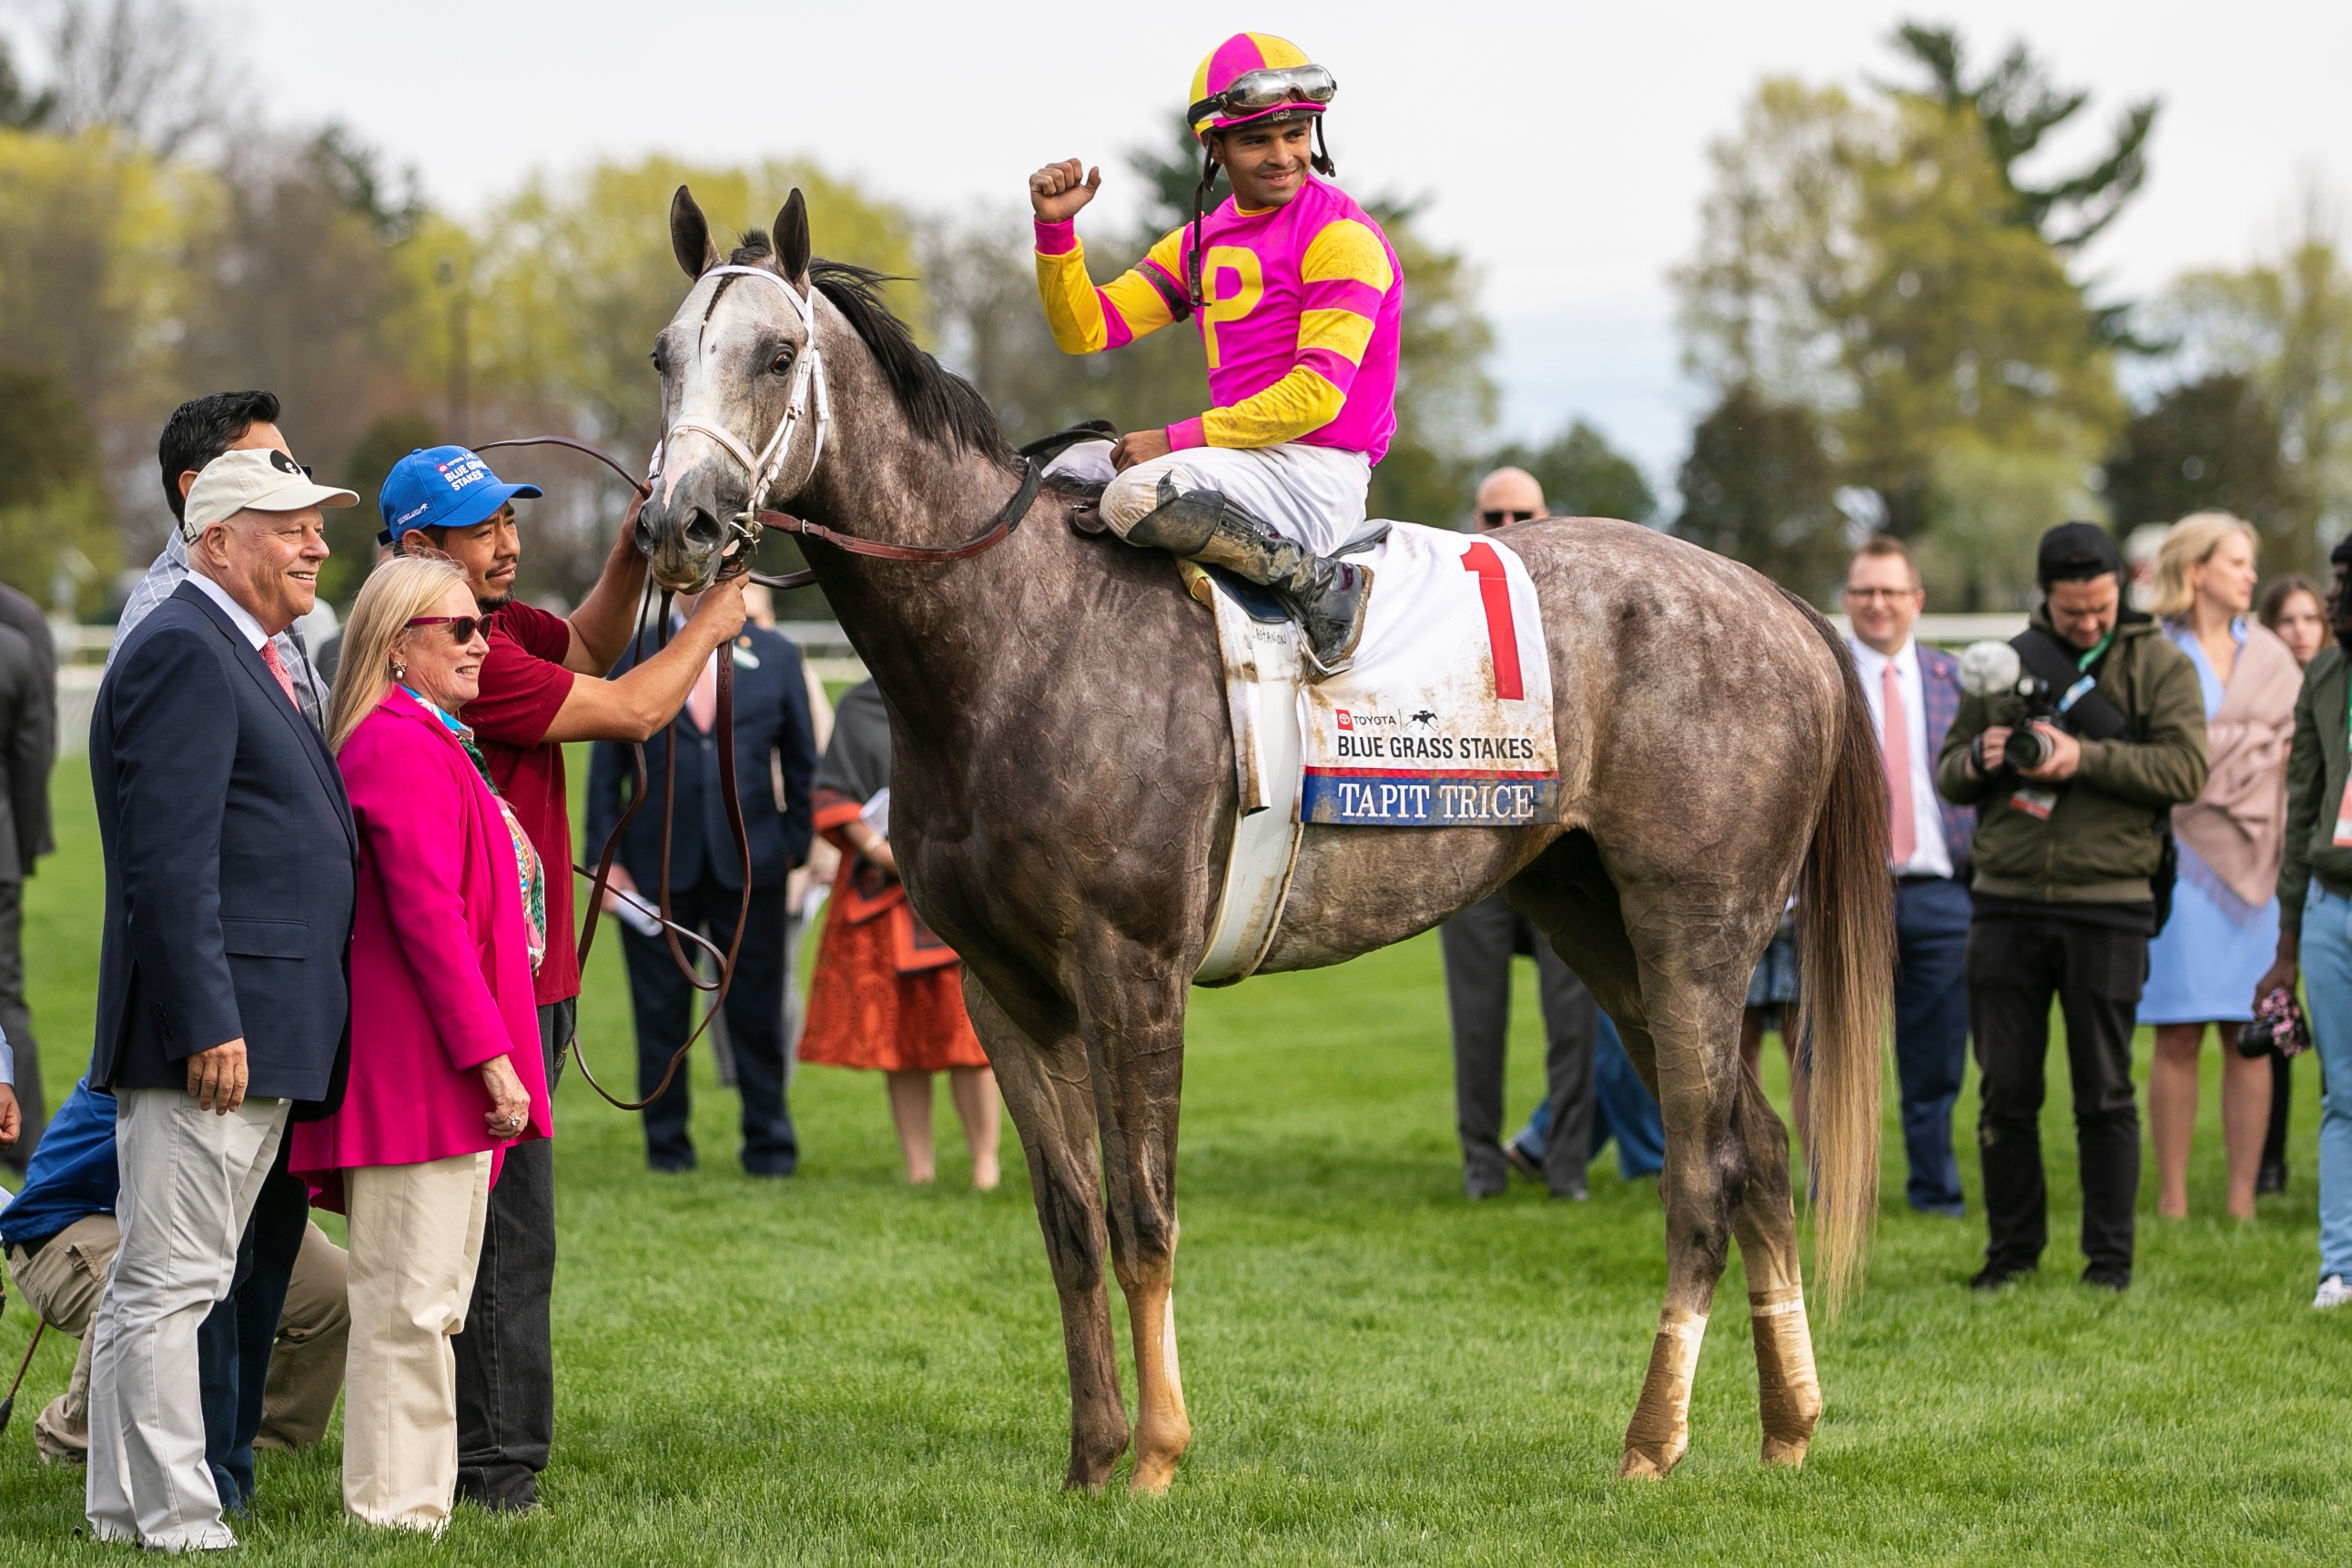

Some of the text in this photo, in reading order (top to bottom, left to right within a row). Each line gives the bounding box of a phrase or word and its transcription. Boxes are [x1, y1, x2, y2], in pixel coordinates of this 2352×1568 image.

[1201, 245, 1265, 369] P
[444, 464, 470, 482] BLUE
[446, 456, 465, 467] TOYOTA
[451, 469, 484, 491] STAKES
[1459, 541, 1525, 701] 1
[1353, 715, 1397, 726] TOYOTA
[1338, 735, 1534, 759] BLUE GRASS STAKES
[1338, 783, 1534, 819] TAPIT TRICE
